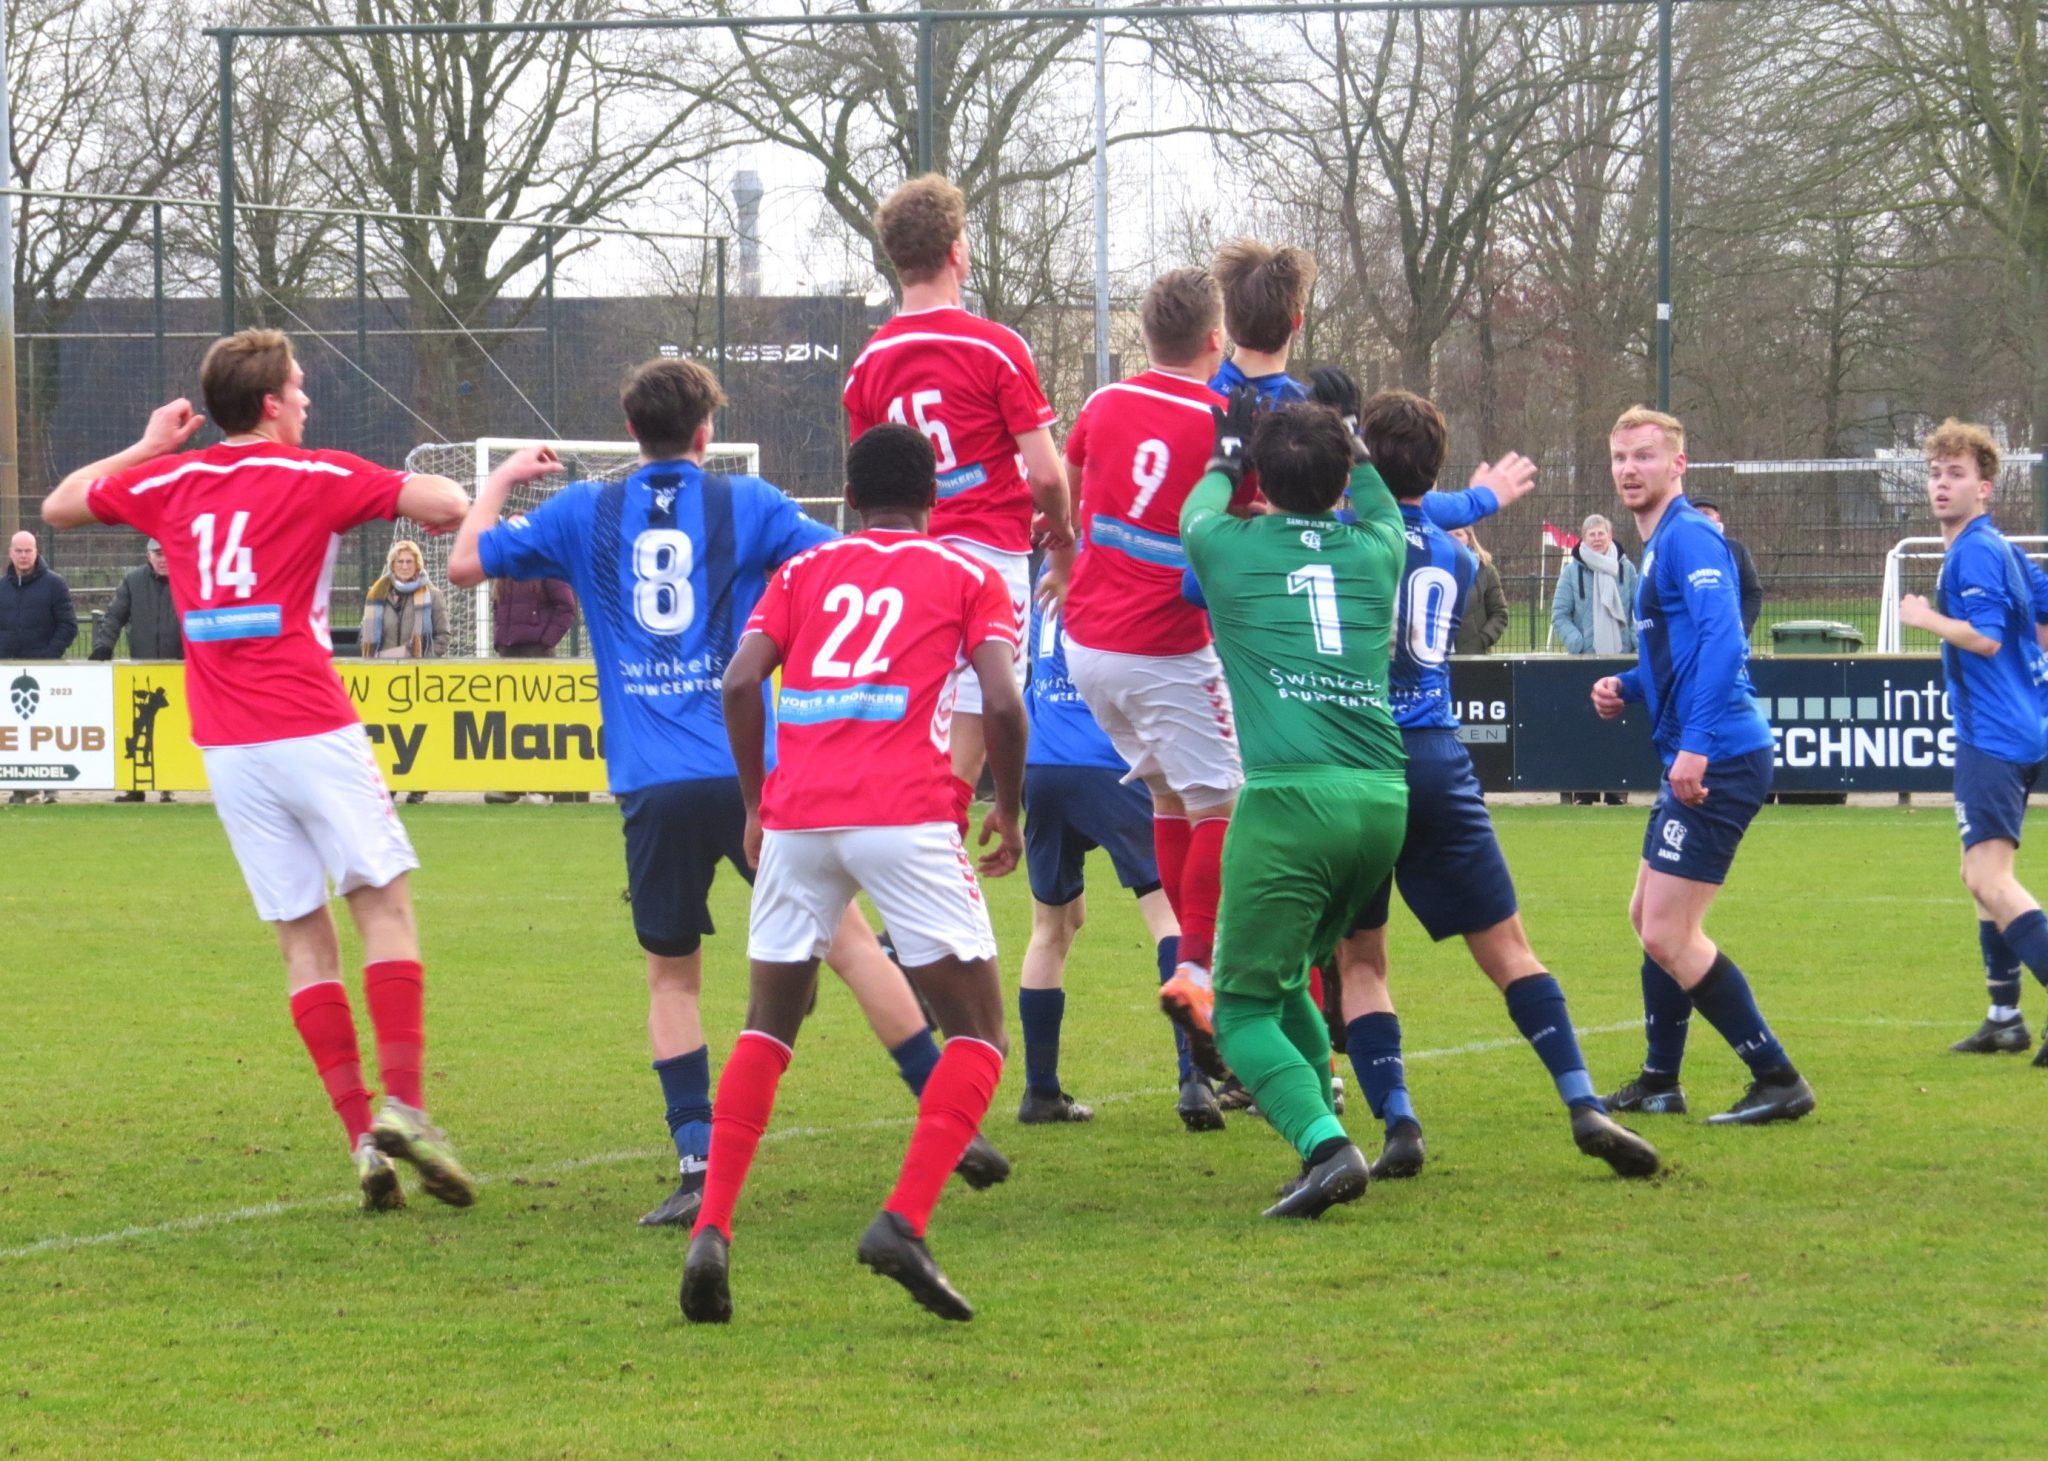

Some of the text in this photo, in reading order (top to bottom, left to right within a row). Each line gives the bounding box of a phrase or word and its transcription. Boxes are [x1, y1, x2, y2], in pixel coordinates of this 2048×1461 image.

[1126, 438, 1170, 519] 9
[190, 510, 258, 600] 14
[632, 528, 695, 636] 8
[811, 583, 904, 678] 22
[1286, 564, 1342, 655] 1
[1390, 566, 1458, 668] 0
[50, 688, 73, 696] 2023
[388, 666, 600, 714] glazenwas
[779, 695, 823, 709] VOETS
[839, 690, 905, 705] DONKERS
[30, 726, 106, 752] PUB
[453, 711, 608, 761] Man
[0, 766, 69, 779] HIJNDEL
